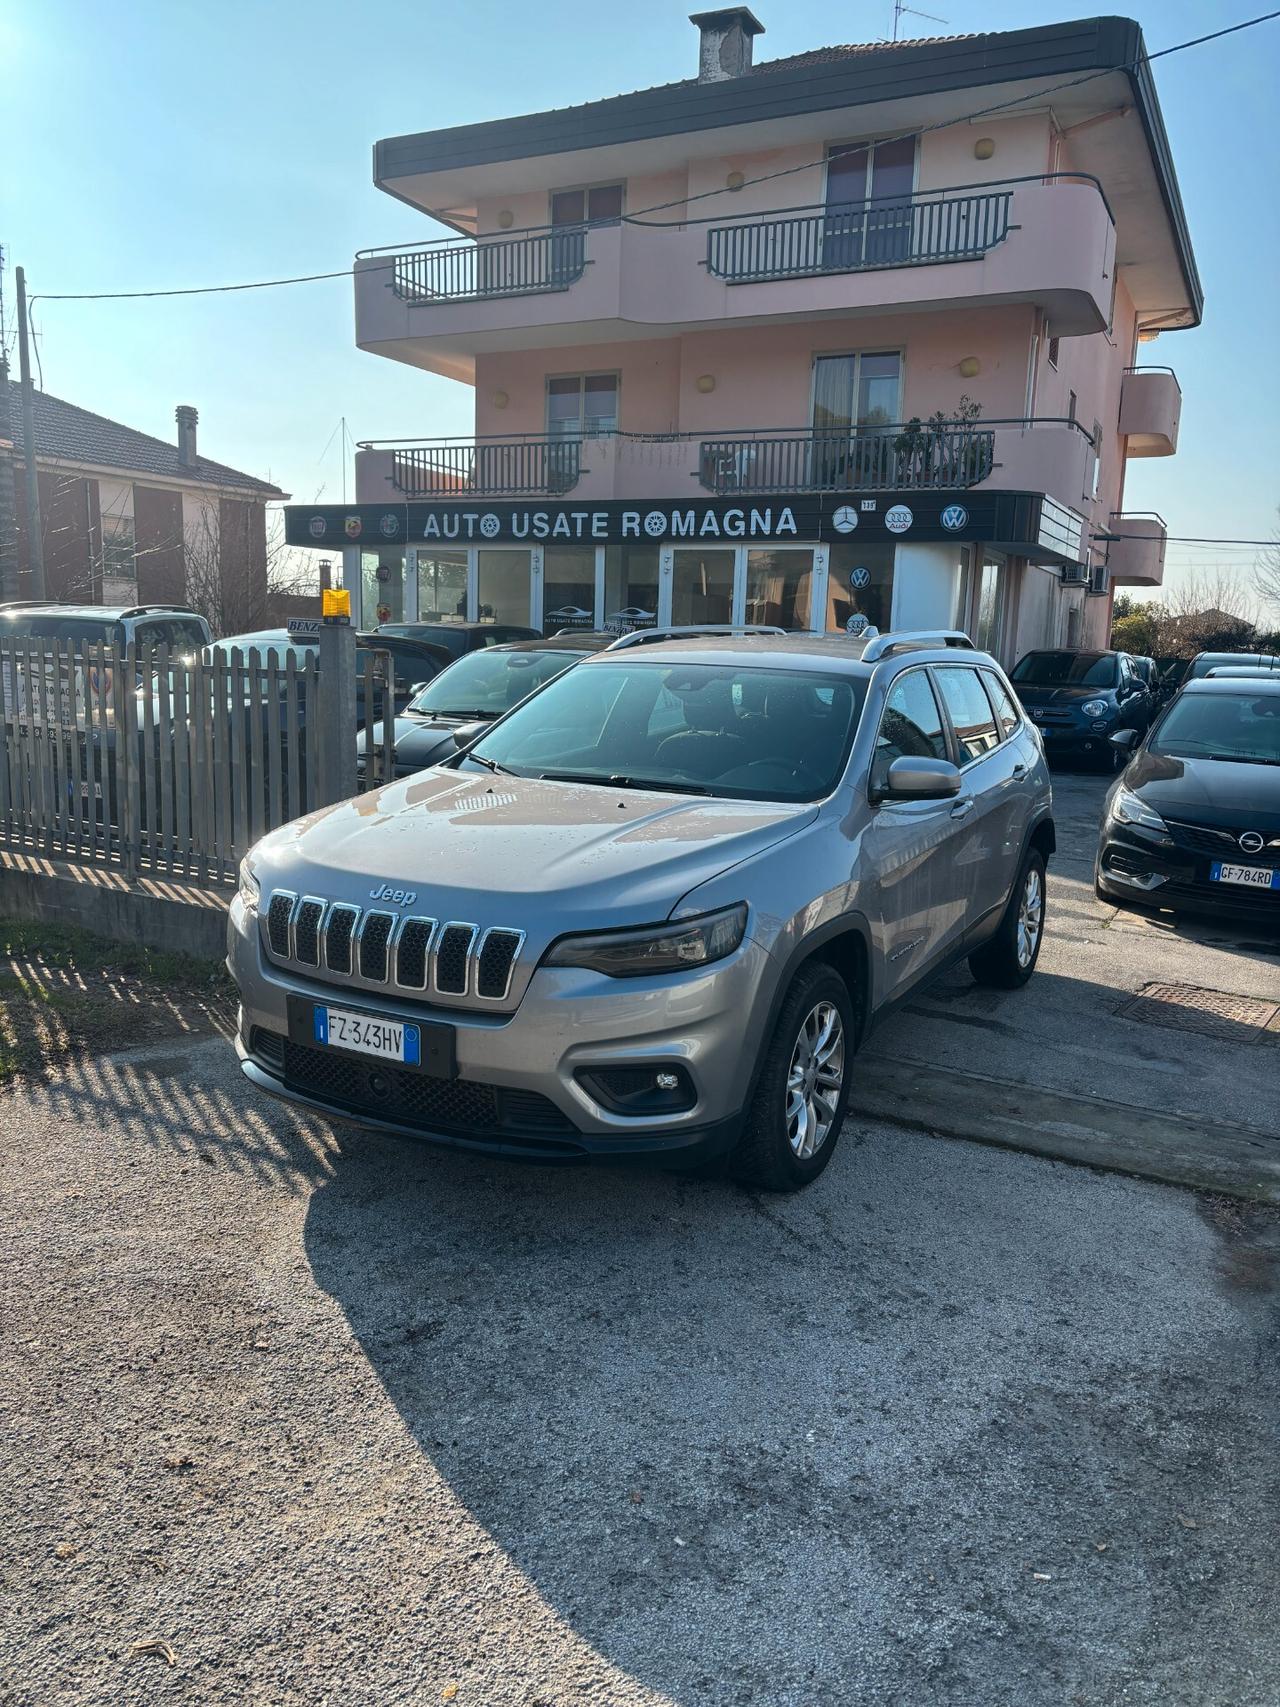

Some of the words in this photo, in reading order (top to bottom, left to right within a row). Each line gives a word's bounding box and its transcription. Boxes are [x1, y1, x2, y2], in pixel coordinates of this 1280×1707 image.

[423, 513, 500, 538] AUTO
[511, 512, 609, 538] USATE
[621, 507, 798, 537] ROMAGNA
[289, 621, 320, 633] BENZ
[370, 884, 417, 907] Jeep
